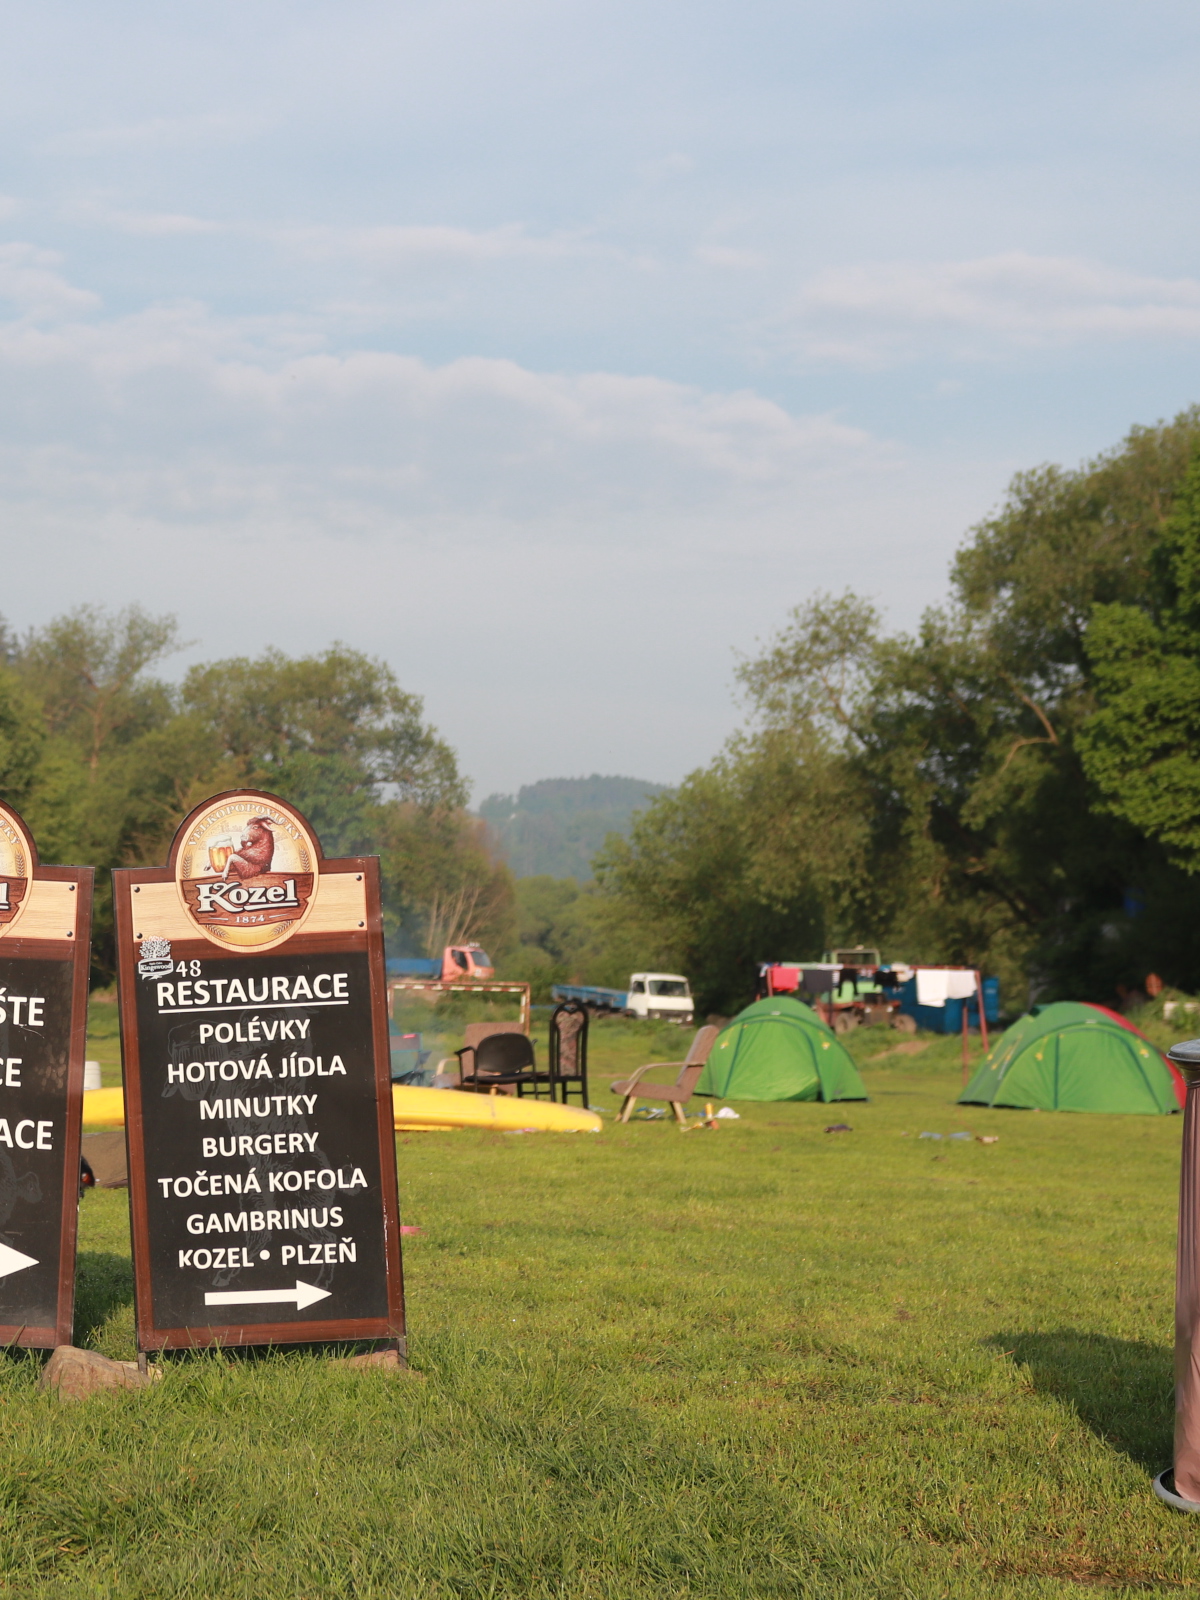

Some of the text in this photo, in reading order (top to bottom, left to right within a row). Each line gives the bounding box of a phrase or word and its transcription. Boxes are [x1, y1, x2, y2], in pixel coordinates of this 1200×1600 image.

[196, 879, 298, 913] Kozel
[235, 914, 265, 923] 1874
[175, 959, 202, 978] 48
[156, 973, 349, 1007] RESTAURACE
[199, 1016, 311, 1044] POLÉVKY
[167, 1053, 347, 1083] HOTOVÁ JÍDLA
[200, 1094, 318, 1120] MINUTKY
[202, 1132, 319, 1158] BURGERY
[158, 1168, 367, 1198] TOČENÁ KOFOLA
[186, 1206, 344, 1235] GAMBRINUS
[178, 1237, 357, 1270] KOZEL PLZEŇ
